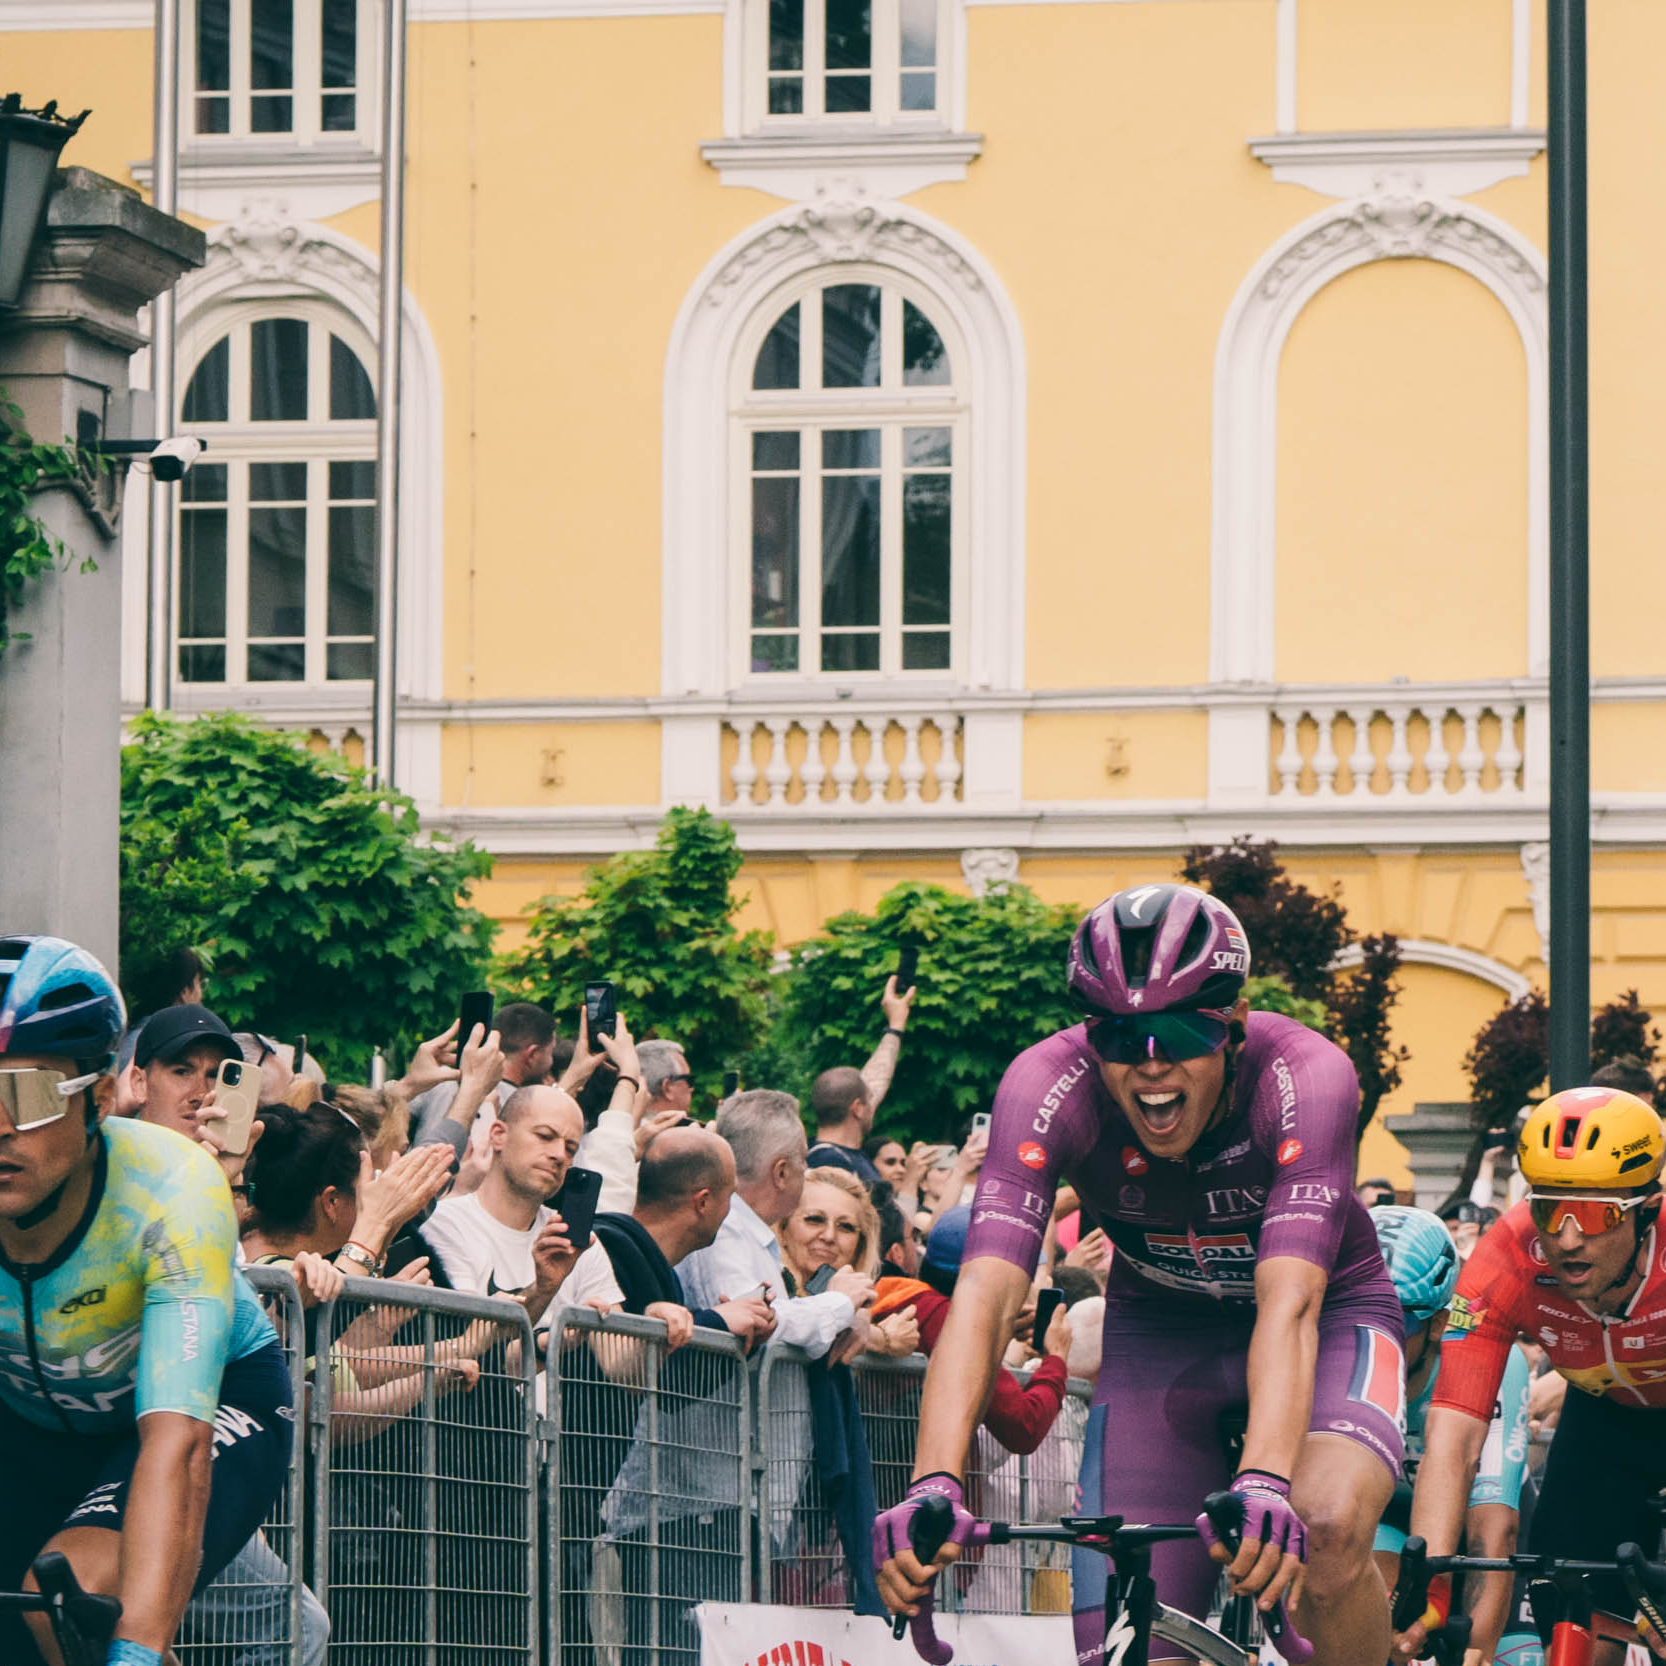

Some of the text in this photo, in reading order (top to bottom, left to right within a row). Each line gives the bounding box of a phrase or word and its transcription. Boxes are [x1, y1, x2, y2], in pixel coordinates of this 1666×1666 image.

[1033, 1058, 1090, 1135] CASTELLI
[1271, 1057, 1297, 1132] CASTELLI
[1622, 1135, 1653, 1156] sweet
[1289, 1183, 1333, 1202] ITA
[1537, 1304, 1593, 1324] RIDLEY
[1519, 1651, 1544, 1666] FT
